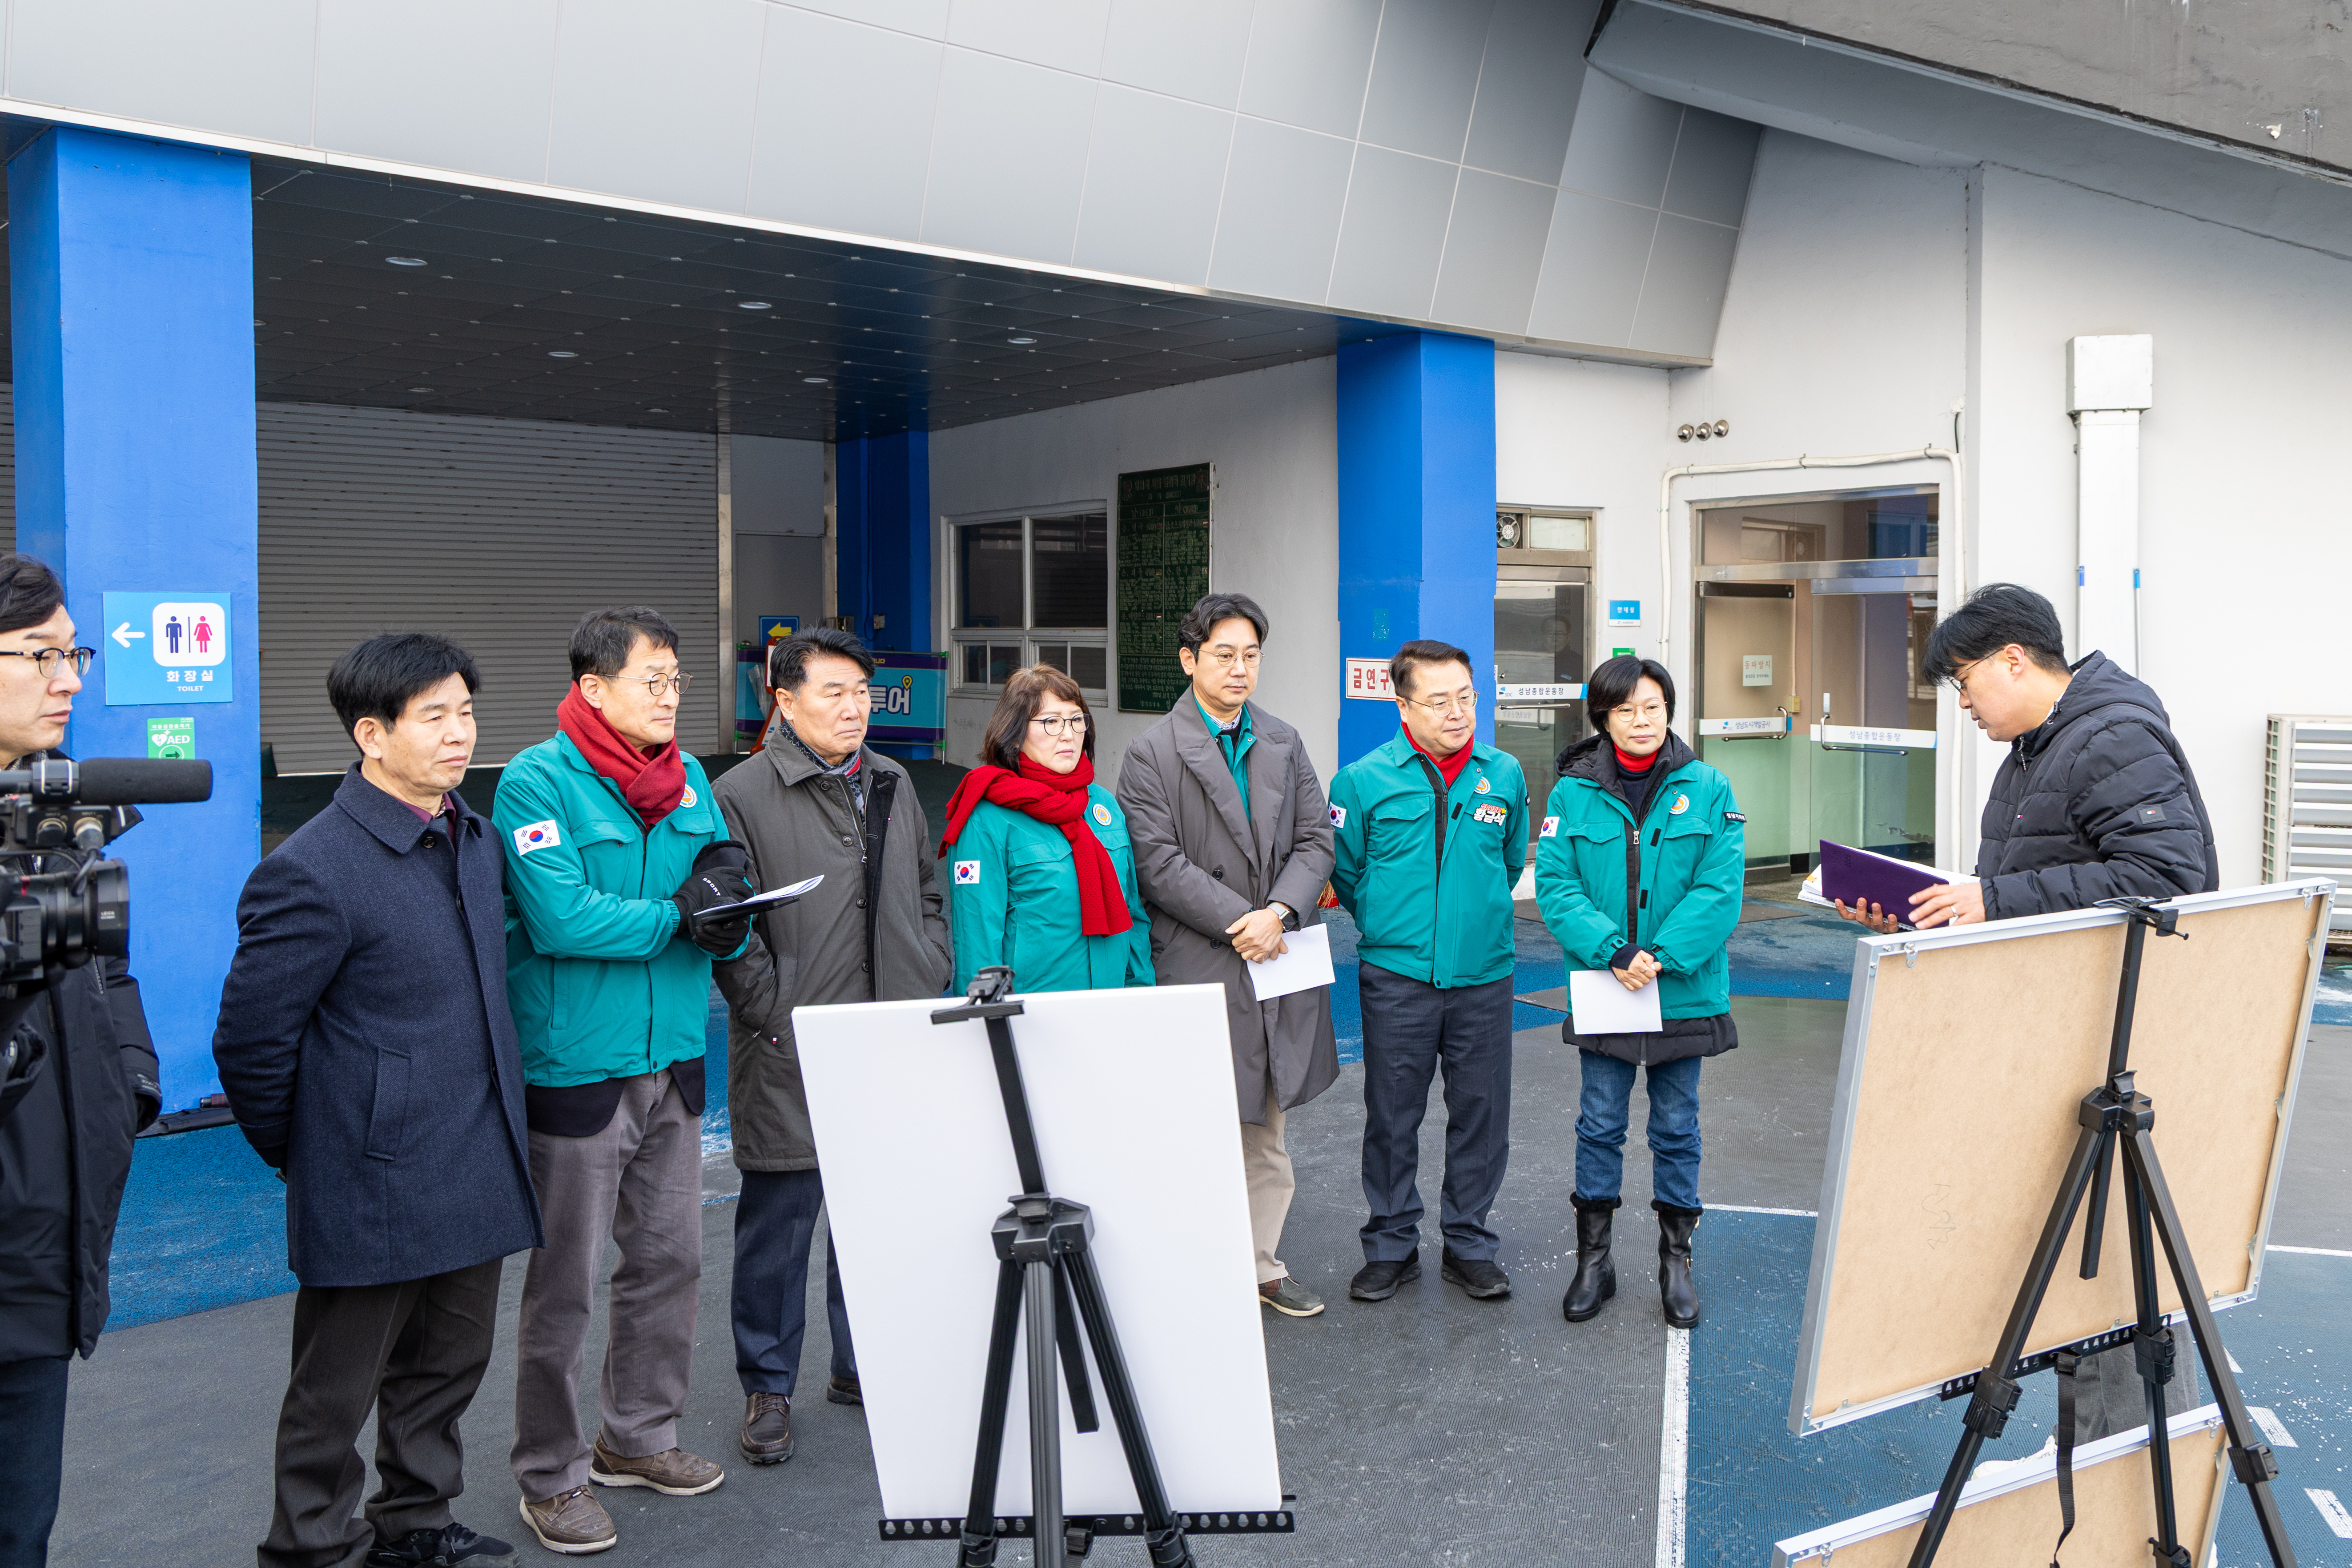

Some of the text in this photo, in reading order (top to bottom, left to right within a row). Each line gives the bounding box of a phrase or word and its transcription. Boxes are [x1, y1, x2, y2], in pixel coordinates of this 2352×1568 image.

[1745, 660, 1771, 670] 동파방지
[166, 670, 213, 682] 화장실
[1353, 668, 1390, 691] 금연구
[1518, 687, 1564, 696] 성남종합운동장
[1735, 720, 1771, 730] 성남도시개발공사
[166, 735, 190, 744] AED
[1849, 730, 1901, 742] 성남종합운동장
[1473, 808, 1506, 826] 황금석
[703, 877, 721, 896] SPORT
